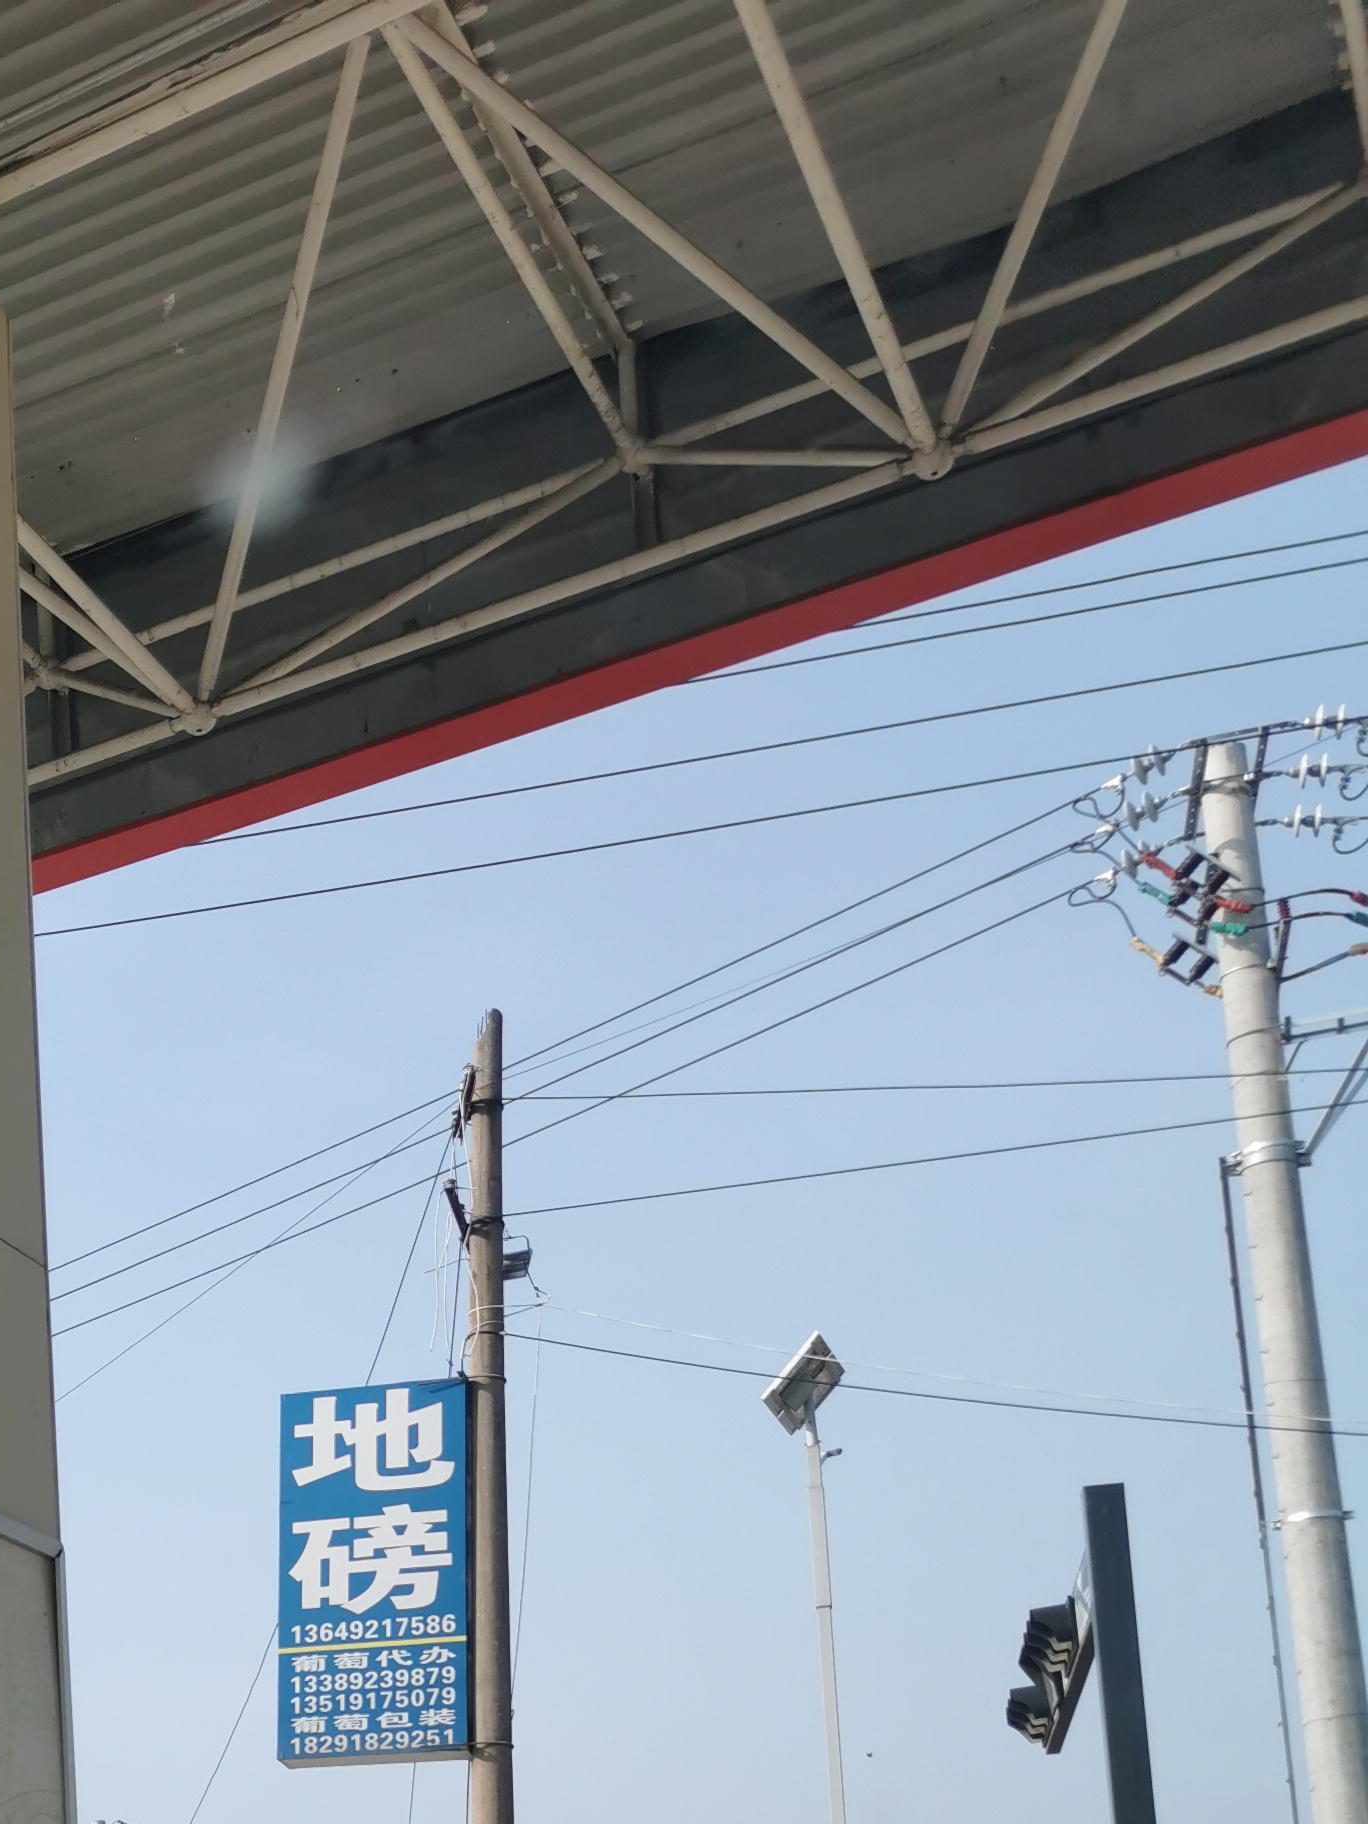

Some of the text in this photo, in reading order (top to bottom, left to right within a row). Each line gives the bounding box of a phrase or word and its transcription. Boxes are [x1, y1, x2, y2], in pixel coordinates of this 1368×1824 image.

[288, 1387, 455, 1614] 地磅
[290, 1614, 456, 1643] 13649217586
[291, 1647, 457, 1672] 葡萄代办
[290, 1666, 456, 1694] 13389239879
[290, 1687, 456, 1714] 13519175079
[290, 1709, 456, 1734] 葡萄包装
[290, 1729, 455, 1755] 18291829251
